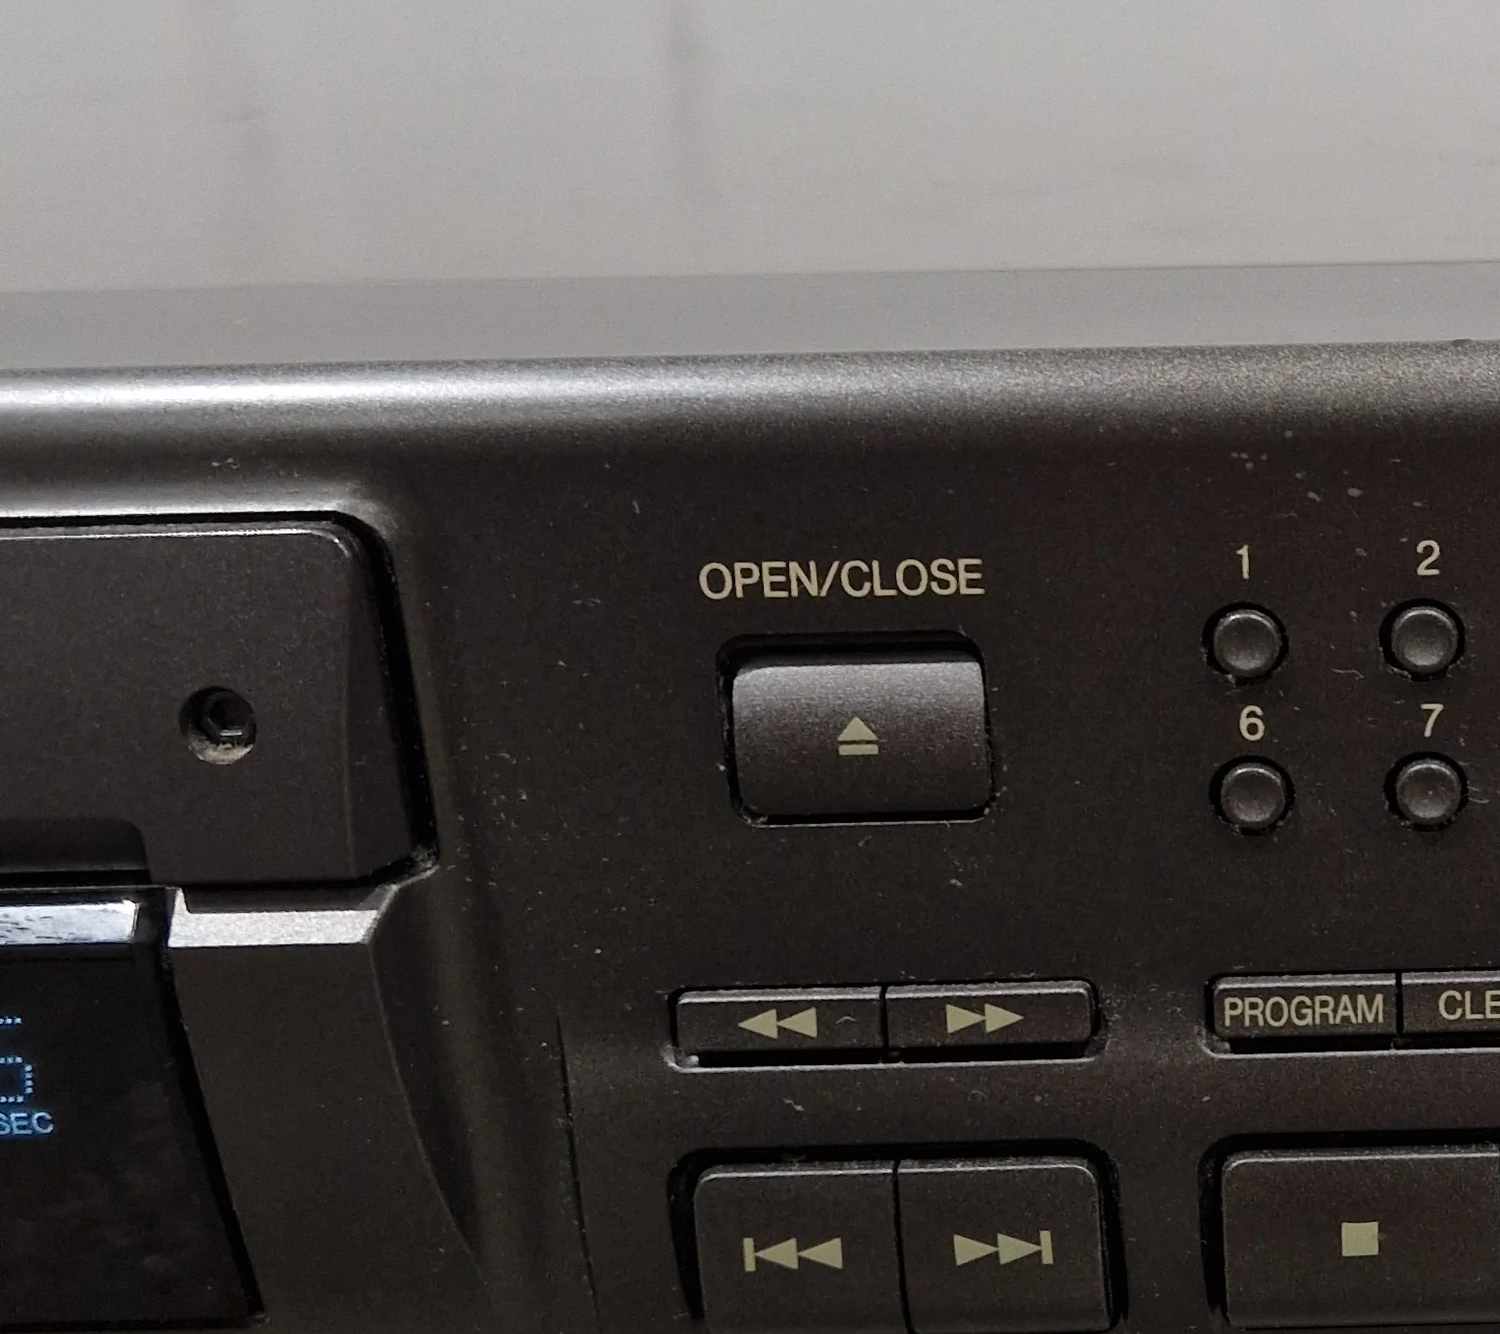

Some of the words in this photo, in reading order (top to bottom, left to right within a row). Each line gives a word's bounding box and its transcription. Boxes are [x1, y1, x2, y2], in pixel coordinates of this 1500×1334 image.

[1235, 544, 1251, 579] 1
[1416, 539, 1441, 576] 2
[698, 558, 986, 600] OPEN/CLOSE
[1239, 705, 1265, 741] 6
[1420, 702, 1444, 738] 7
[1224, 993, 1384, 1027] PROGRAM
